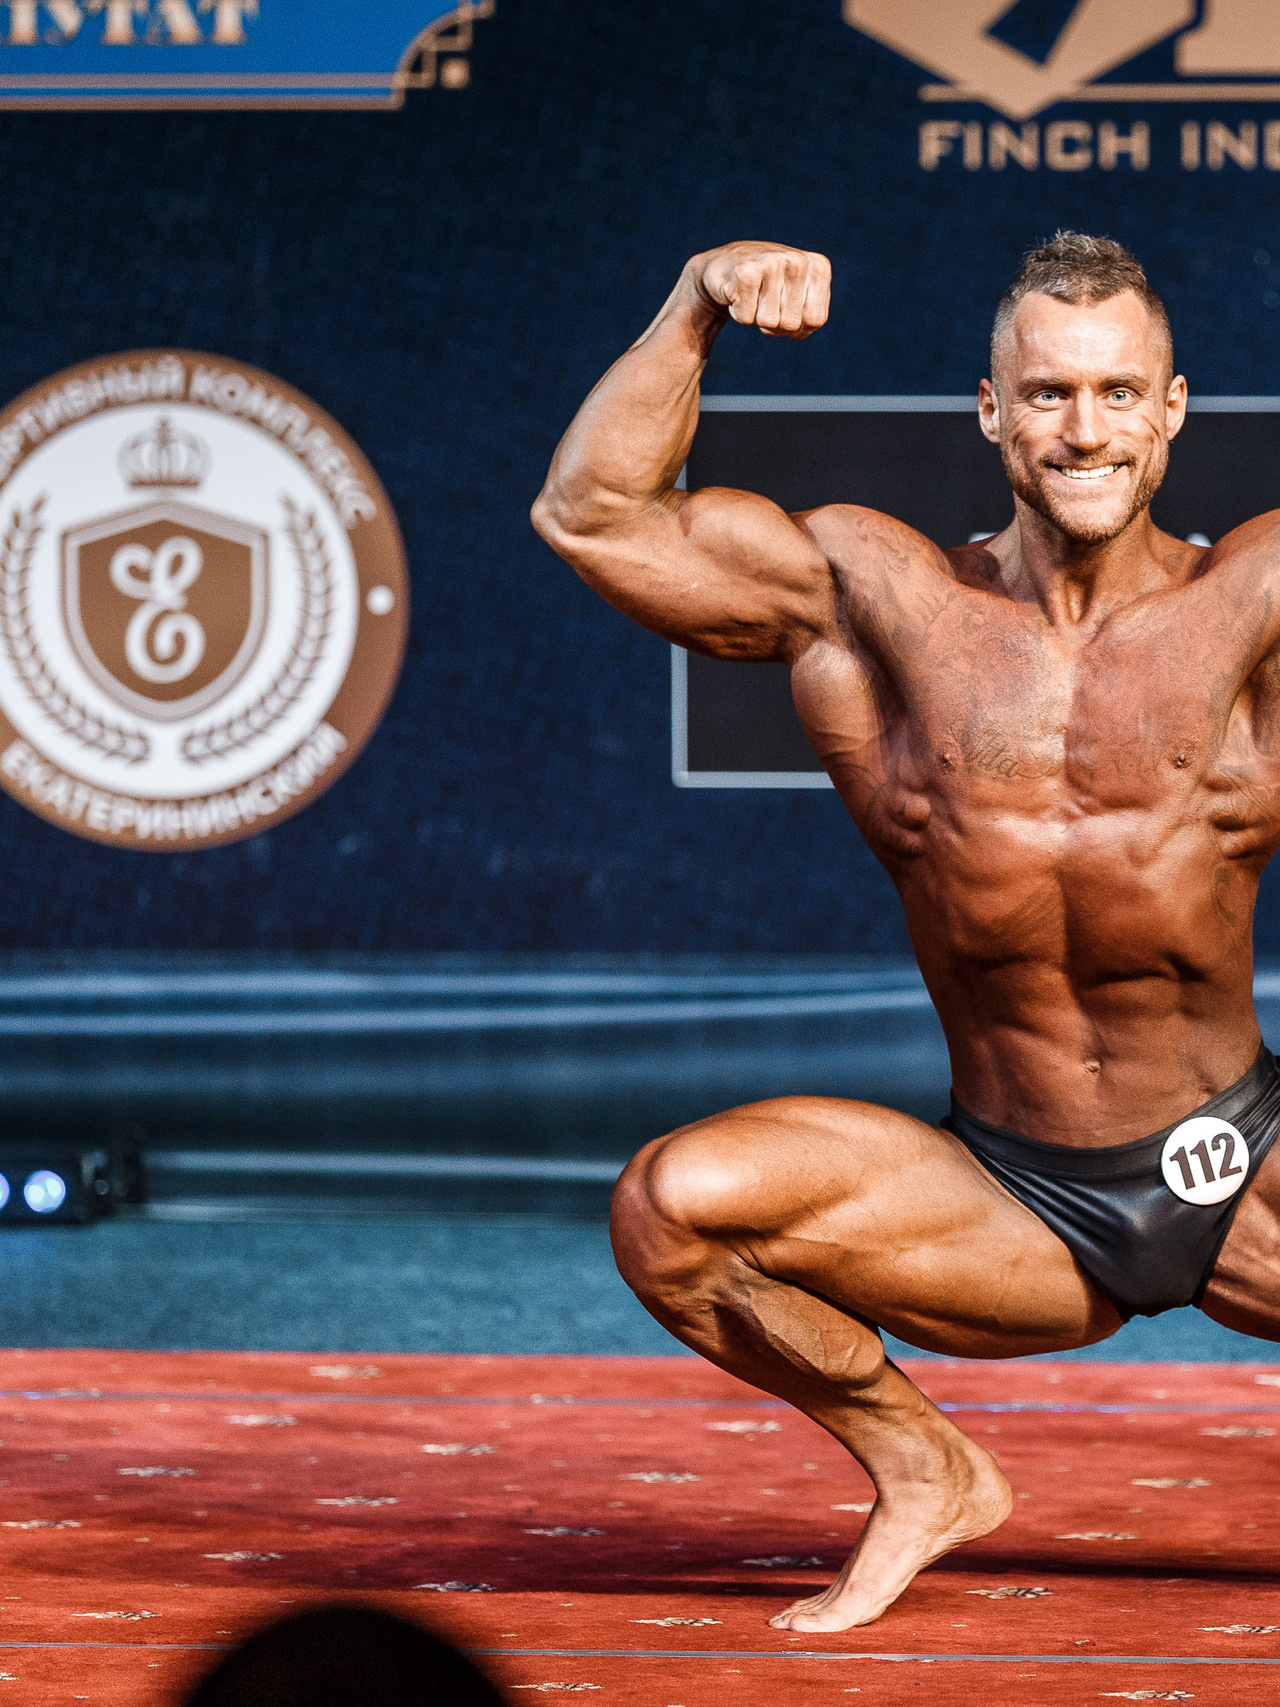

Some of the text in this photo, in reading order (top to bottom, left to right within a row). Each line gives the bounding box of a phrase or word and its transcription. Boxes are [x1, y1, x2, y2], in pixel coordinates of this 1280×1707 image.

[919, 120, 1150, 171] FINCH
[190, 364, 377, 529] КОМПЛЕКС
[1168, 1132, 1243, 1190] 112
